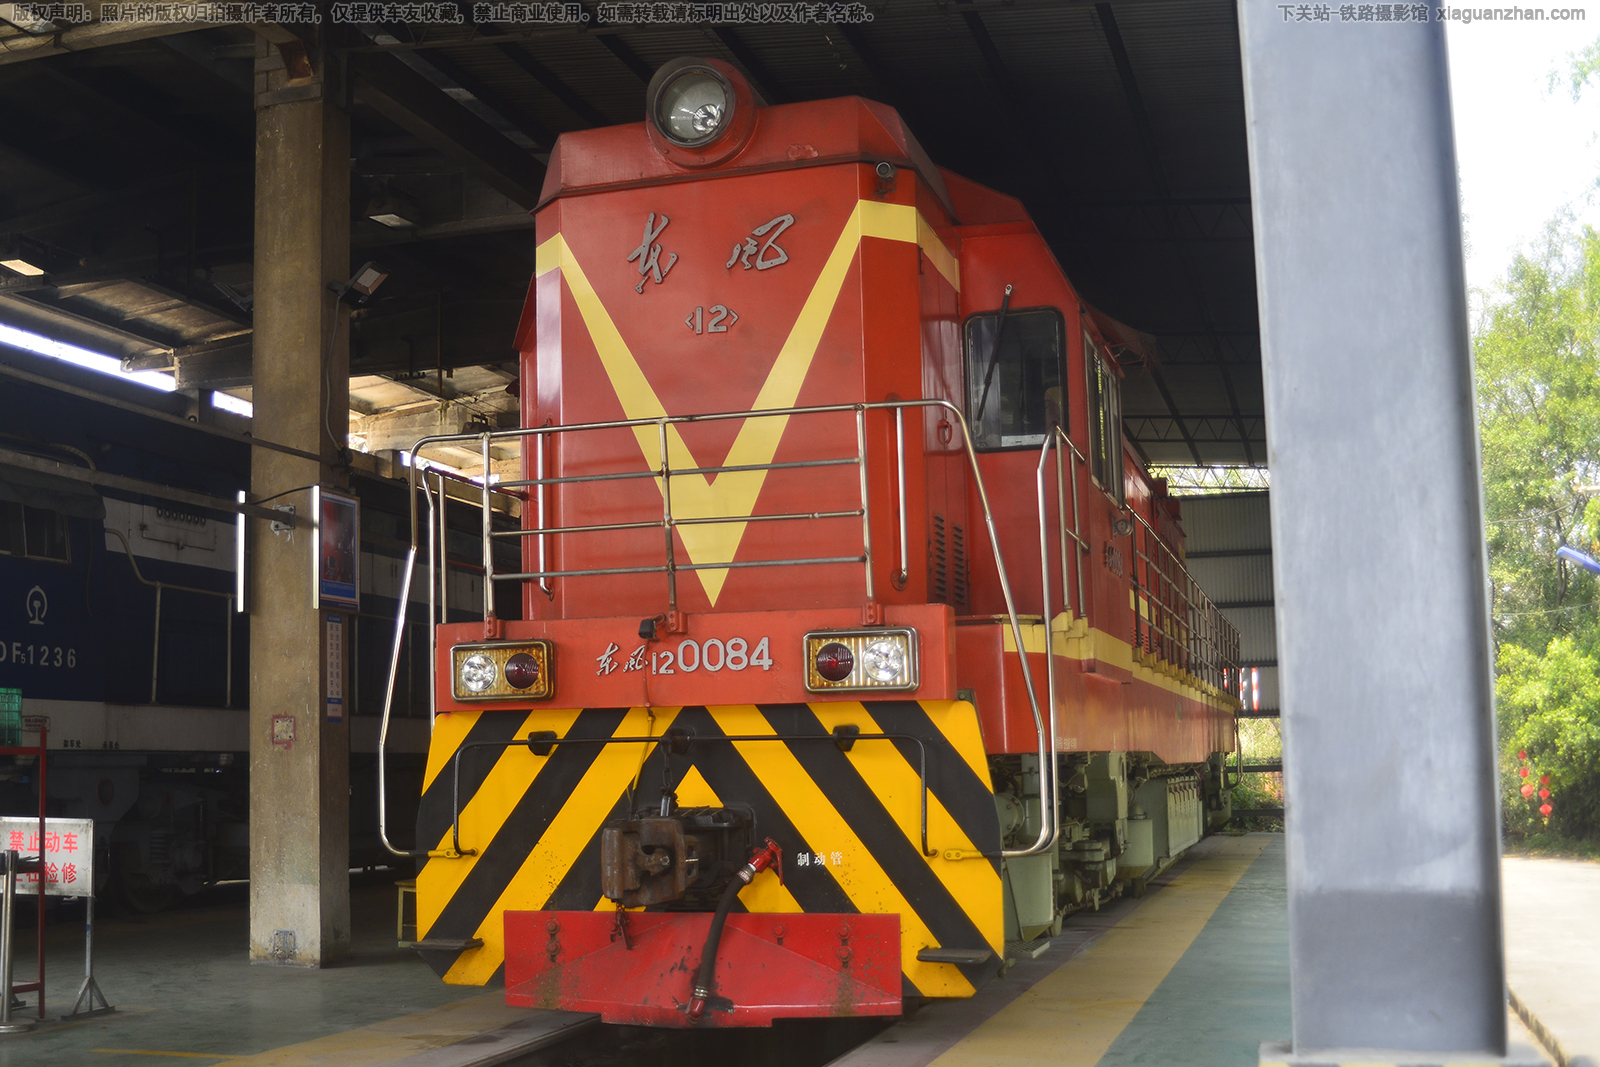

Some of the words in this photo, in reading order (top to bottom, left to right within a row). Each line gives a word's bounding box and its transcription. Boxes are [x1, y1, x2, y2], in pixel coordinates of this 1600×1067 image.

[9, 830, 79, 854] 禁止动车
[797, 851, 843, 867] 制动管
[15, 862, 77, 884] 检修
